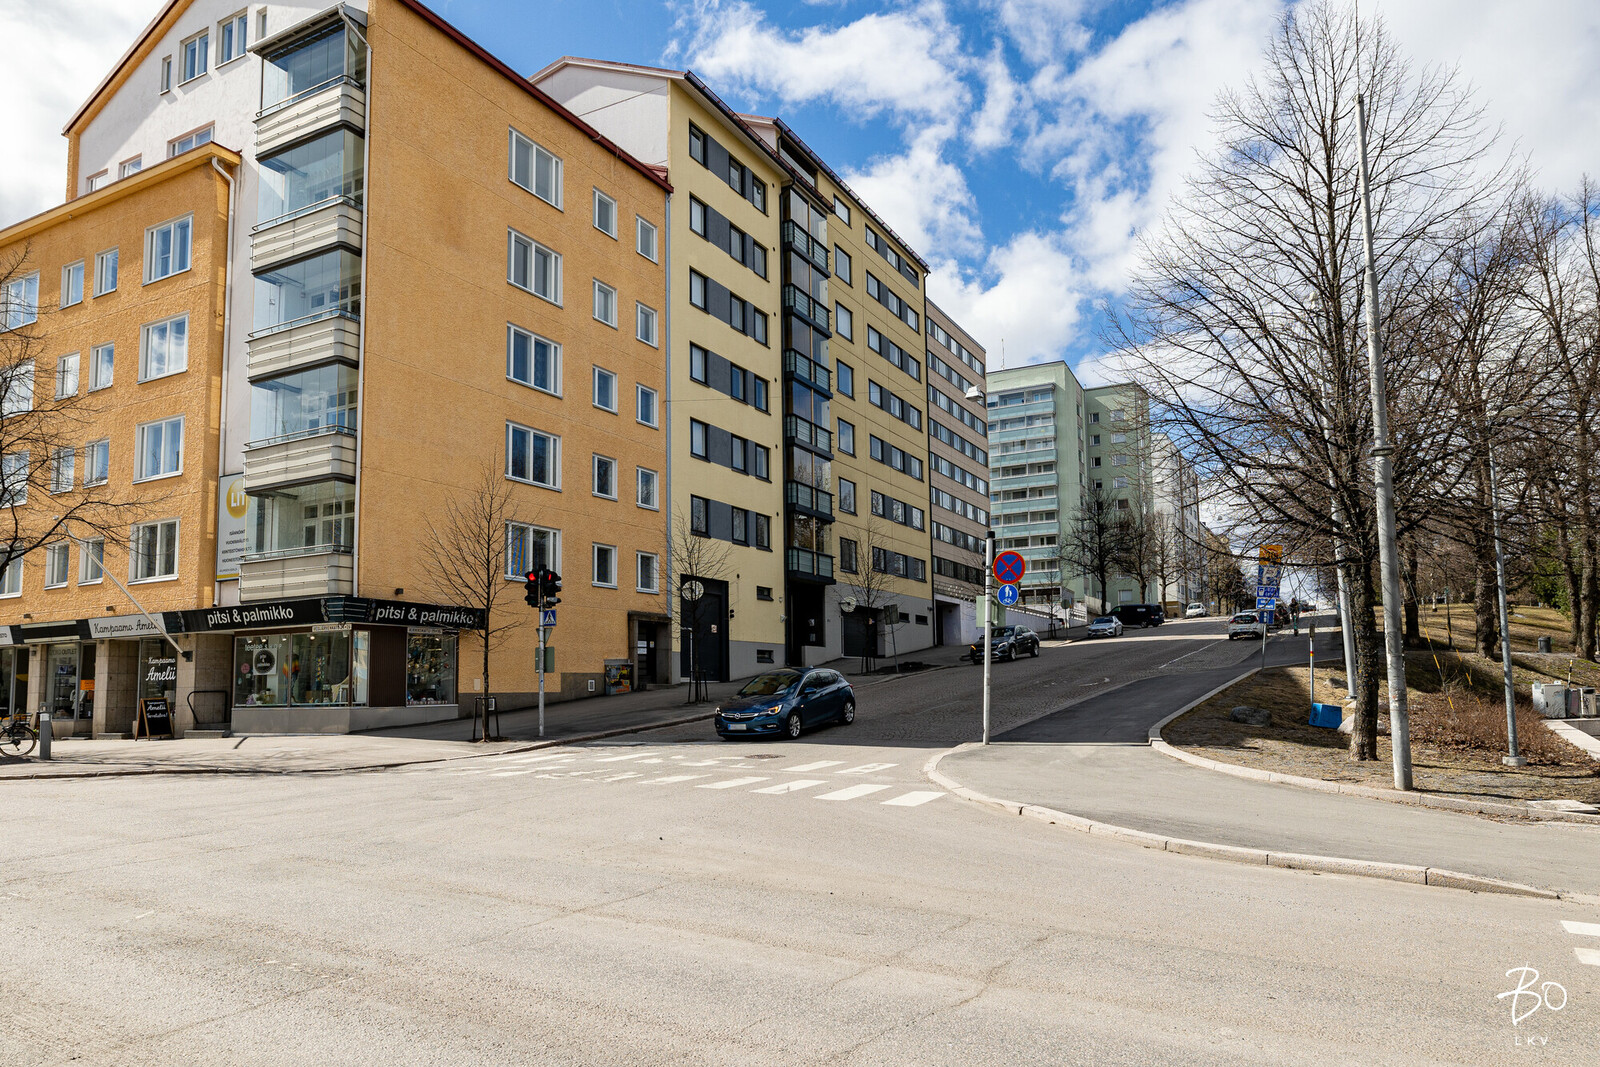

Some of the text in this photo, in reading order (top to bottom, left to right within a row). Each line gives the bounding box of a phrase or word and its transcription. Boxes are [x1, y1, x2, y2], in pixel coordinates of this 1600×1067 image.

[207, 605, 294, 628] pitsi & palmikko
[376, 605, 474, 624] pitsi & palmikko
[94, 623, 133, 635] Kampaamo
[148, 657, 175, 666] Kampaamo
[146, 666, 176, 681] Amelii
